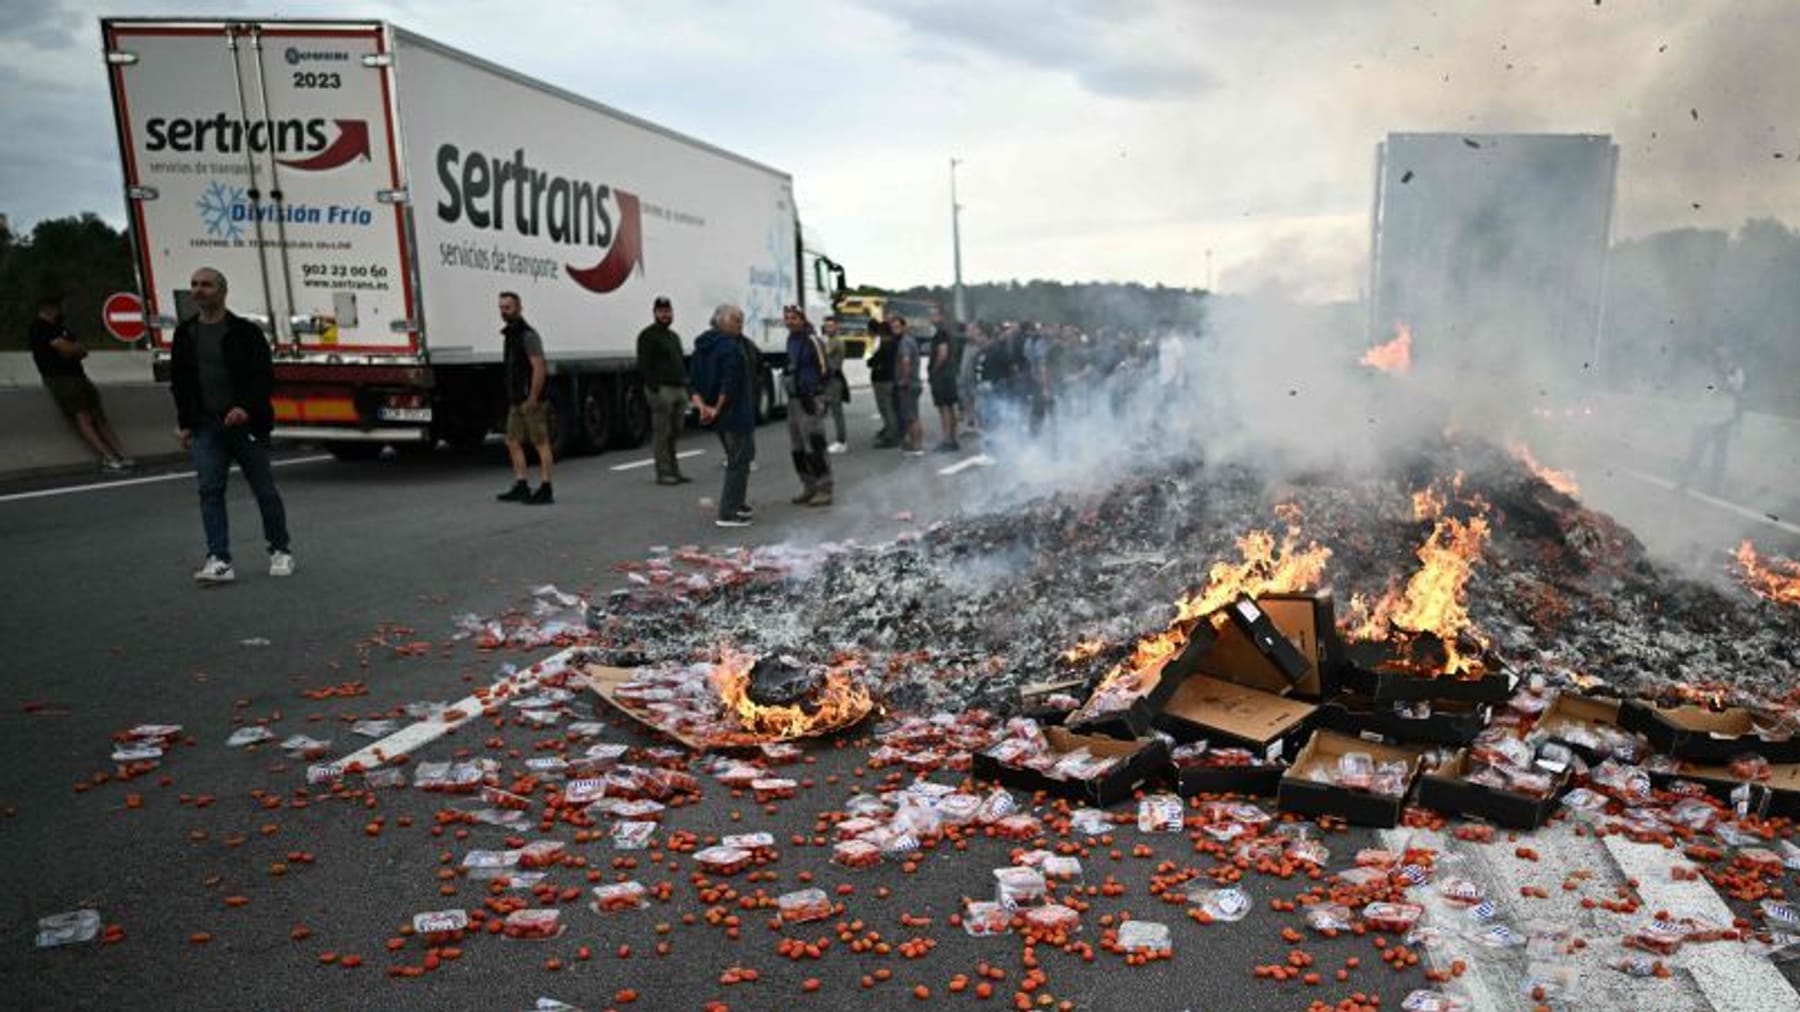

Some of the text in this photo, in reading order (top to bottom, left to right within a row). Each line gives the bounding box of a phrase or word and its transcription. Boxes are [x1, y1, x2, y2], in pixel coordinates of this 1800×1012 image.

[293, 72, 342, 89] 2023
[145, 112, 327, 153] sertrans
[436, 143, 613, 248] sertrans
[328, 205, 372, 225] Frío
[303, 264, 327, 277] 902
[351, 266, 368, 277] 00
[369, 264, 387, 277] 60
[440, 240, 559, 283] servicios de transporte
